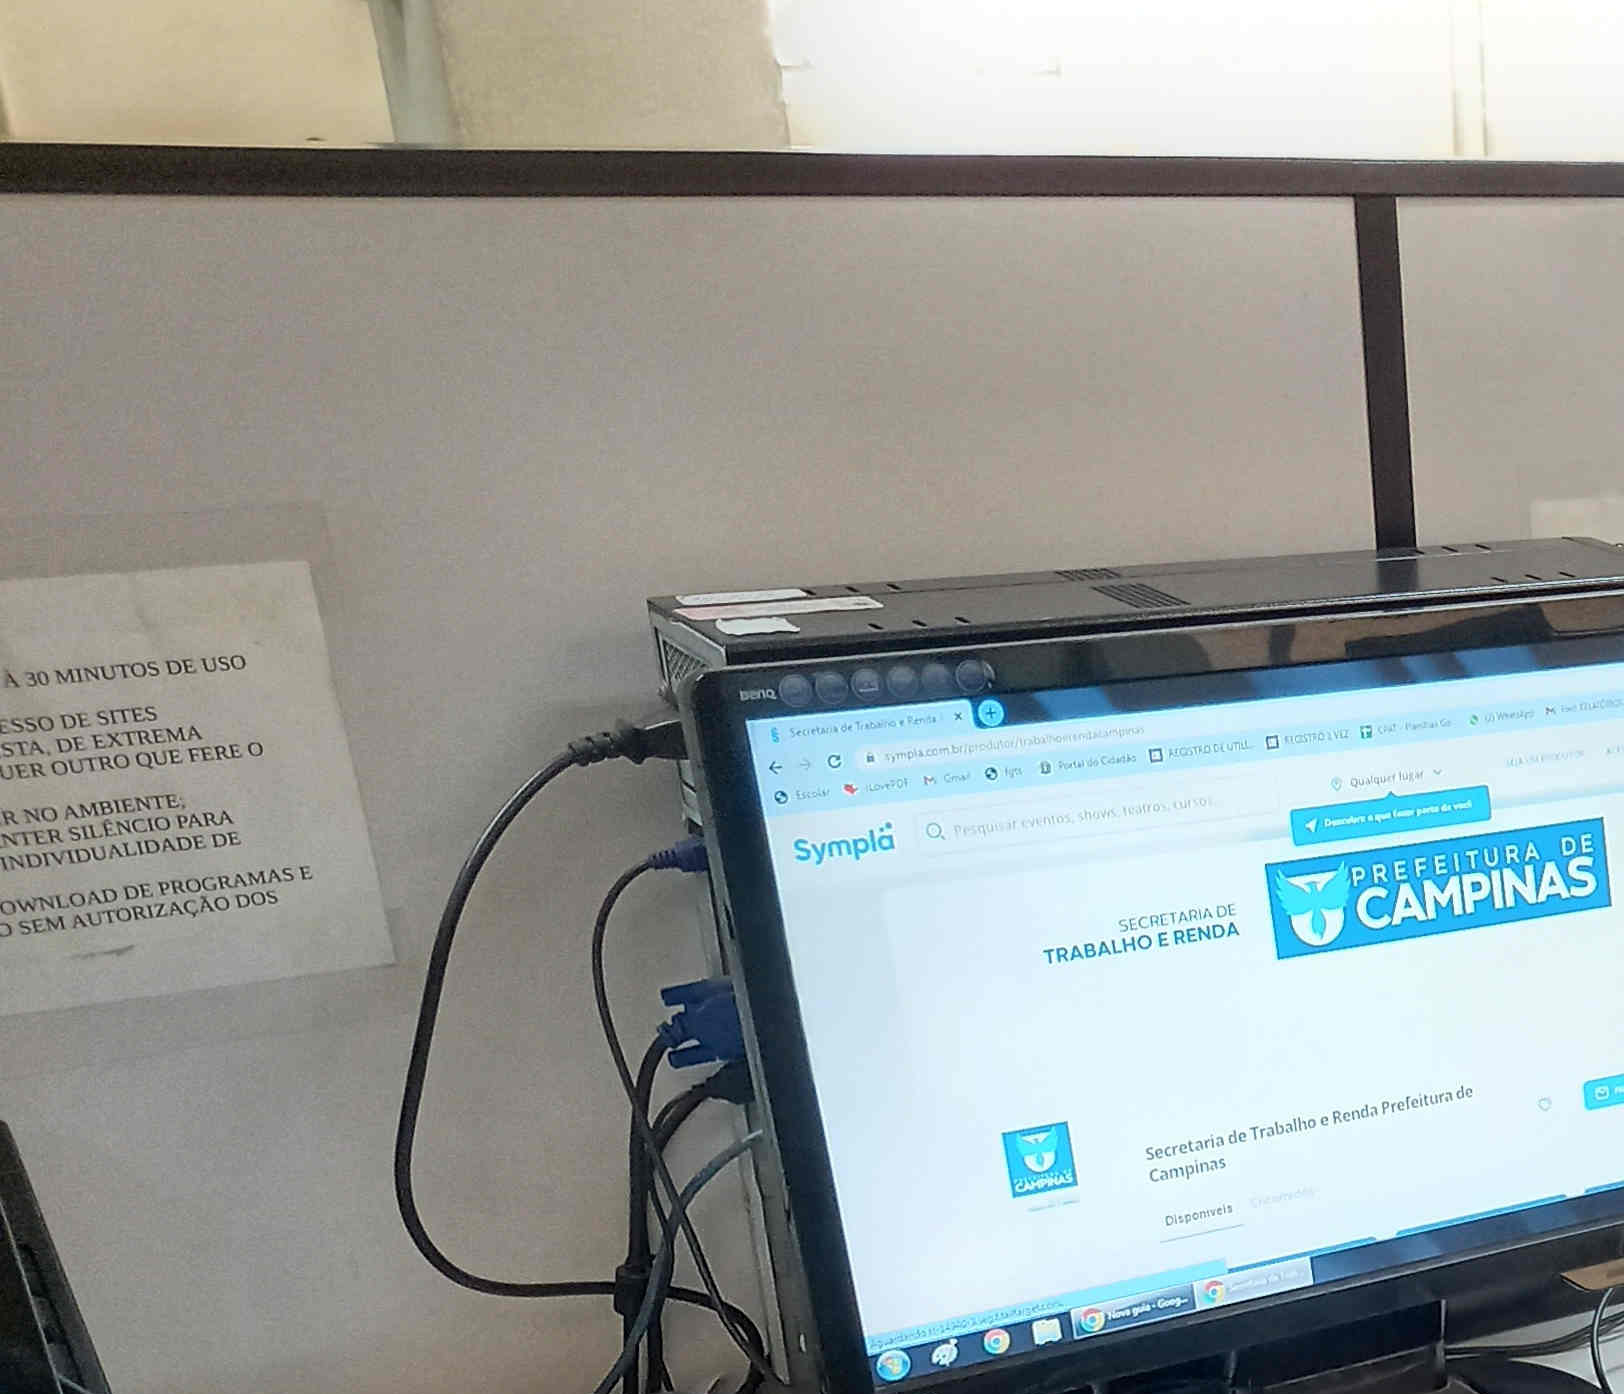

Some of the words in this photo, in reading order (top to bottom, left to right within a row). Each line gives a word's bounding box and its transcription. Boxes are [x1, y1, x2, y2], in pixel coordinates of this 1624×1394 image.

[27, 671, 49, 687] 30
[55, 661, 160, 684] MINUTOS
[166, 658, 197, 676] DE
[202, 655, 247, 673] USO
[60, 713, 91, 730] DE
[97, 706, 158, 726] SITES
[57, 736, 87, 754] DE
[93, 725, 202, 749] EXTREMA
[52, 754, 129, 776] OUTRO
[136, 750, 183, 770] QUE
[189, 744, 242, 762] FERE
[248, 742, 264, 757] O
[23, 806, 58, 824] NO
[69, 815, 171, 842] SILÊNCIO
[177, 810, 235, 830] PARA
[1, 835, 207, 871] INDIVIDUALIDADE
[212, 831, 242, 848] DE
[1351, 840, 1540, 888] PREFEITURA
[1561, 833, 1595, 857] DE
[124, 883, 154, 900] DE
[158, 867, 295, 896] PROGRAMAS
[300, 865, 313, 881] E
[1355, 856, 1598, 930] CAMPINAS
[19, 915, 66, 936] SEM
[72, 895, 231, 930] AUTORIZAÇÃO
[236, 890, 279, 909] DOS
[1119, 907, 1212, 933] SECRETARIA
[1216, 903, 1238, 918] DE
[1043, 933, 1155, 965] TRABALHO
[1158, 930, 1170, 947] E
[1173, 921, 1240, 945] RENDA
[1145, 1133, 1226, 1162] Secretaria
[1228, 1127, 1248, 1146] de
[1250, 1116, 1317, 1142] Trabalho
[1333, 1104, 1379, 1124] Renda
[1381, 1089, 1455, 1116] Prefeitura
[1456, 1084, 1475, 1101] de
[1149, 1155, 1227, 1184] Campinas
